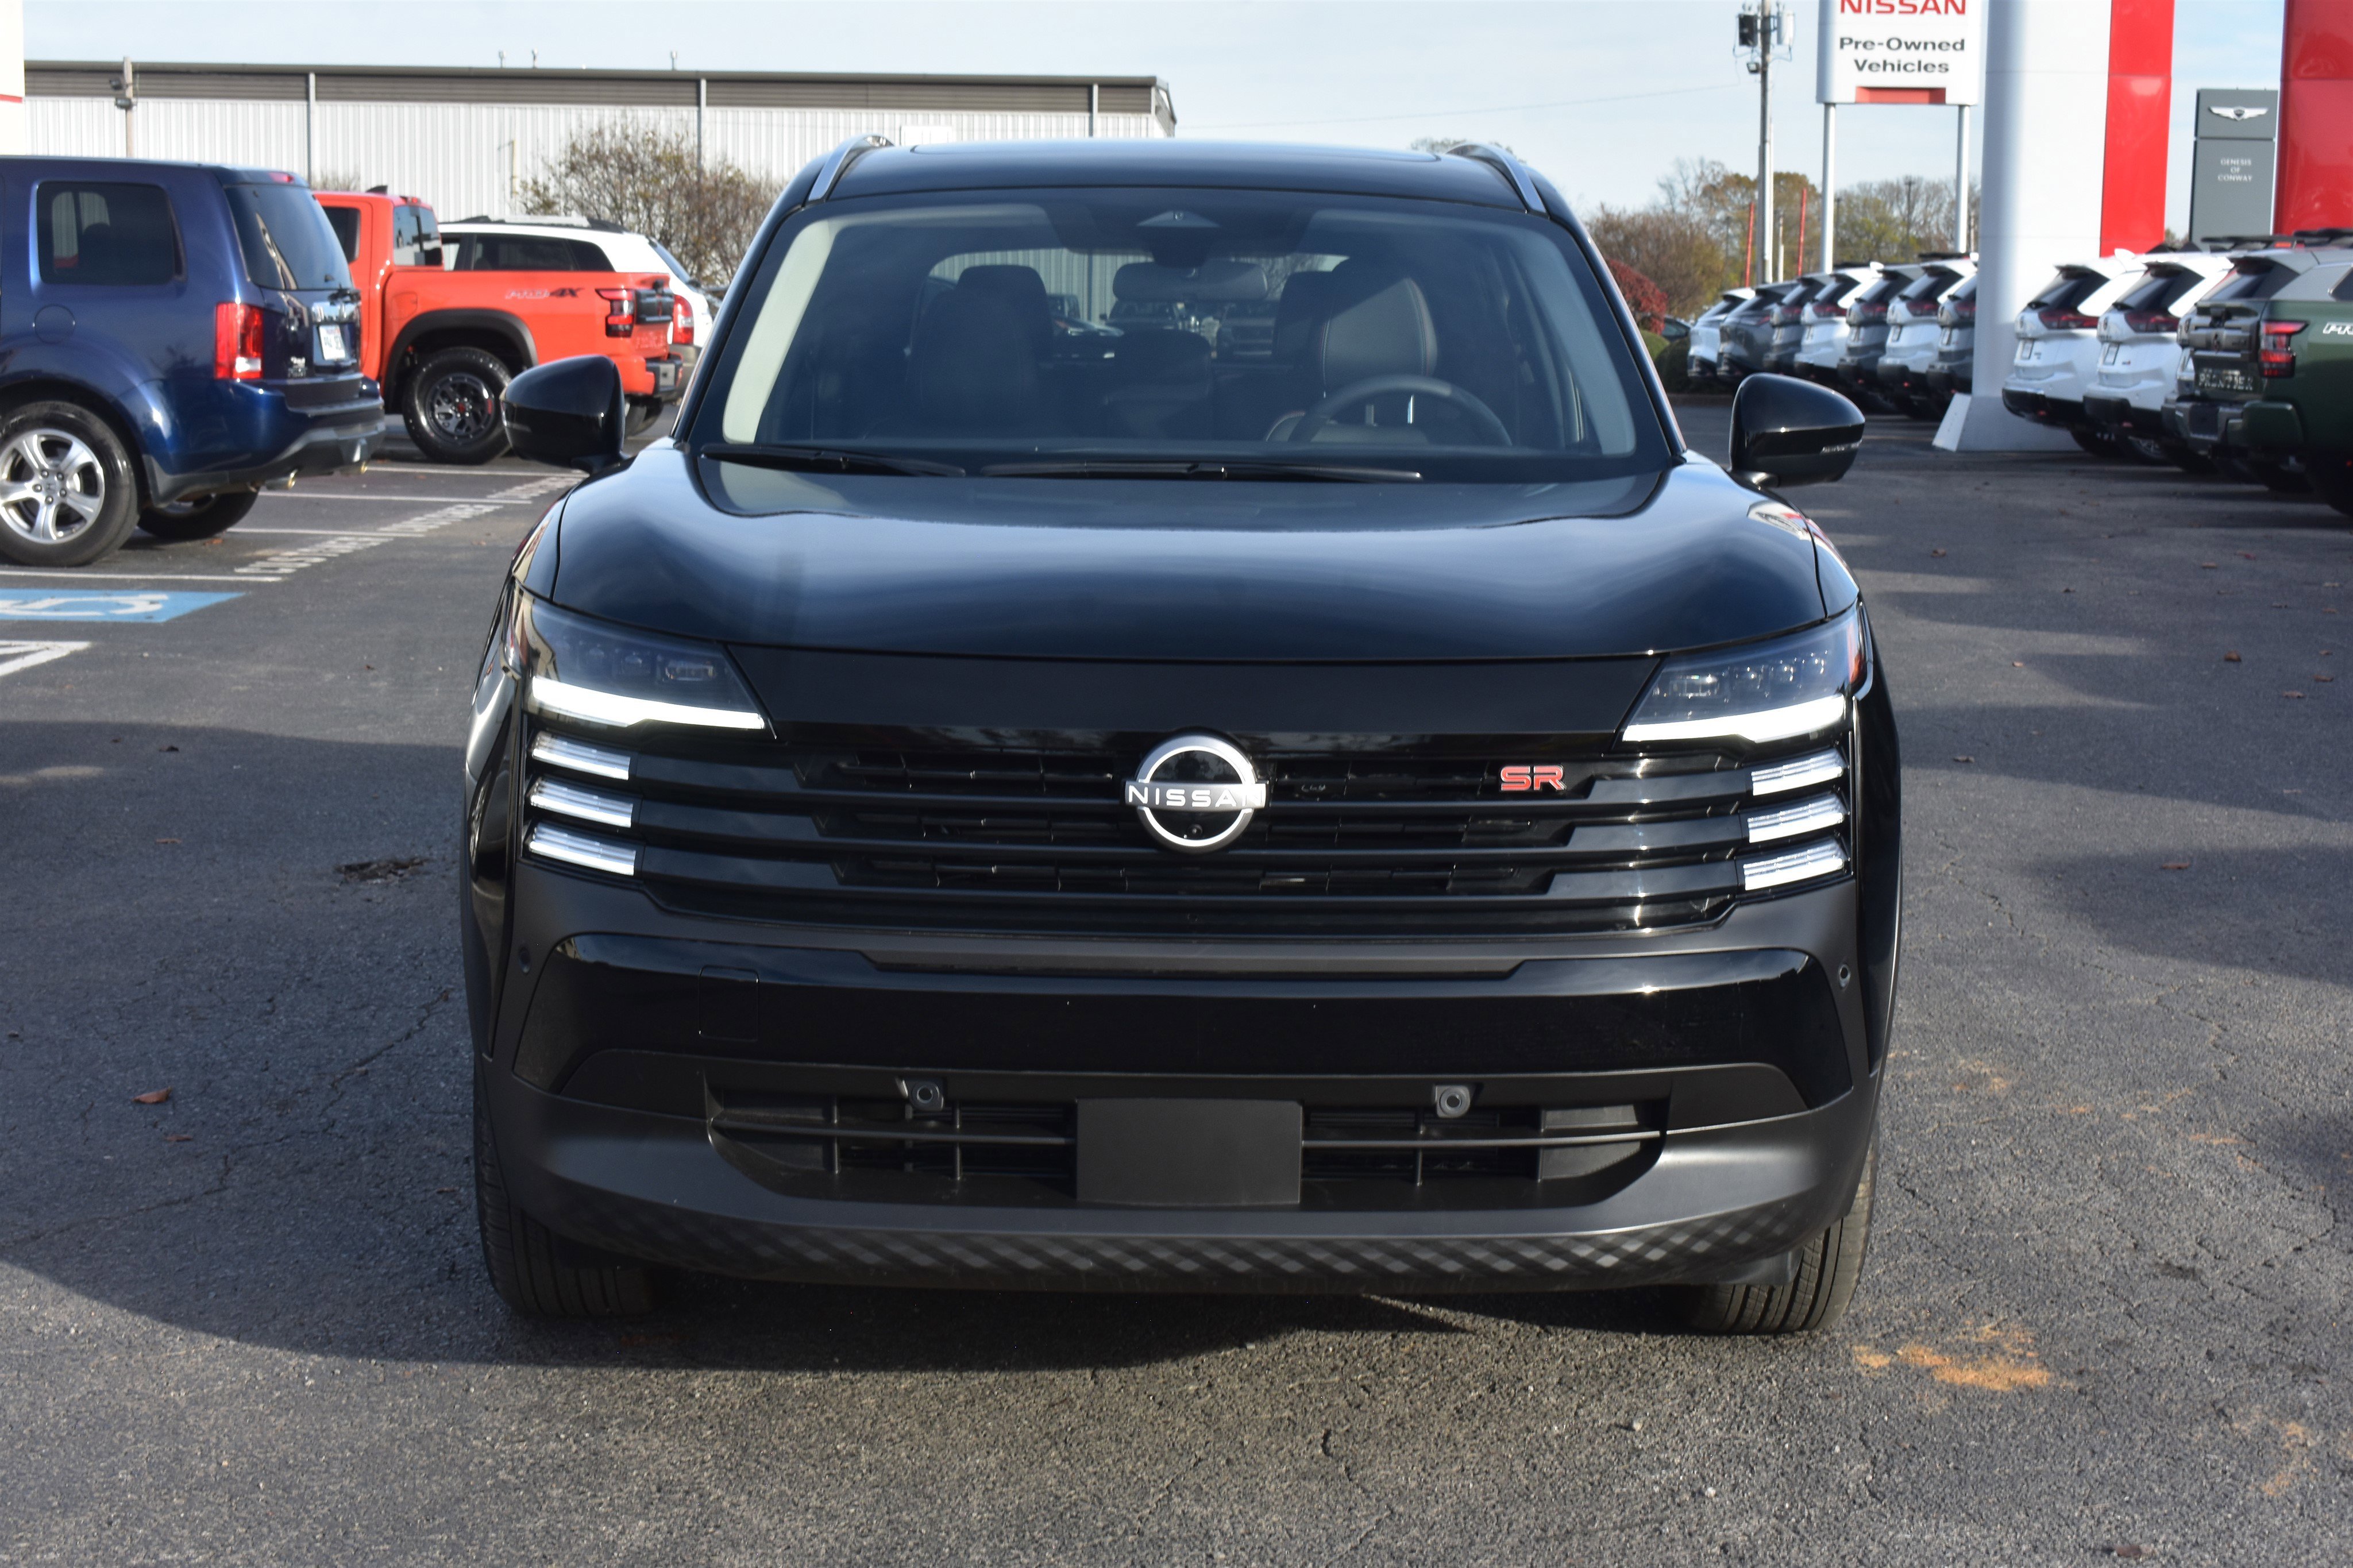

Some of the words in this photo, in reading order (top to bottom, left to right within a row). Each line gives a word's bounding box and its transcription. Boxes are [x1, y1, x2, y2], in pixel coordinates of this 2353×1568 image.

[1840, 0, 1966, 15] NISSAN
[1839, 37, 1965, 51] Pre-Owned
[1854, 59, 1949, 73] Vehicles
[1500, 765, 1567, 791] SR
[1128, 785, 1262, 808] NISSAN
